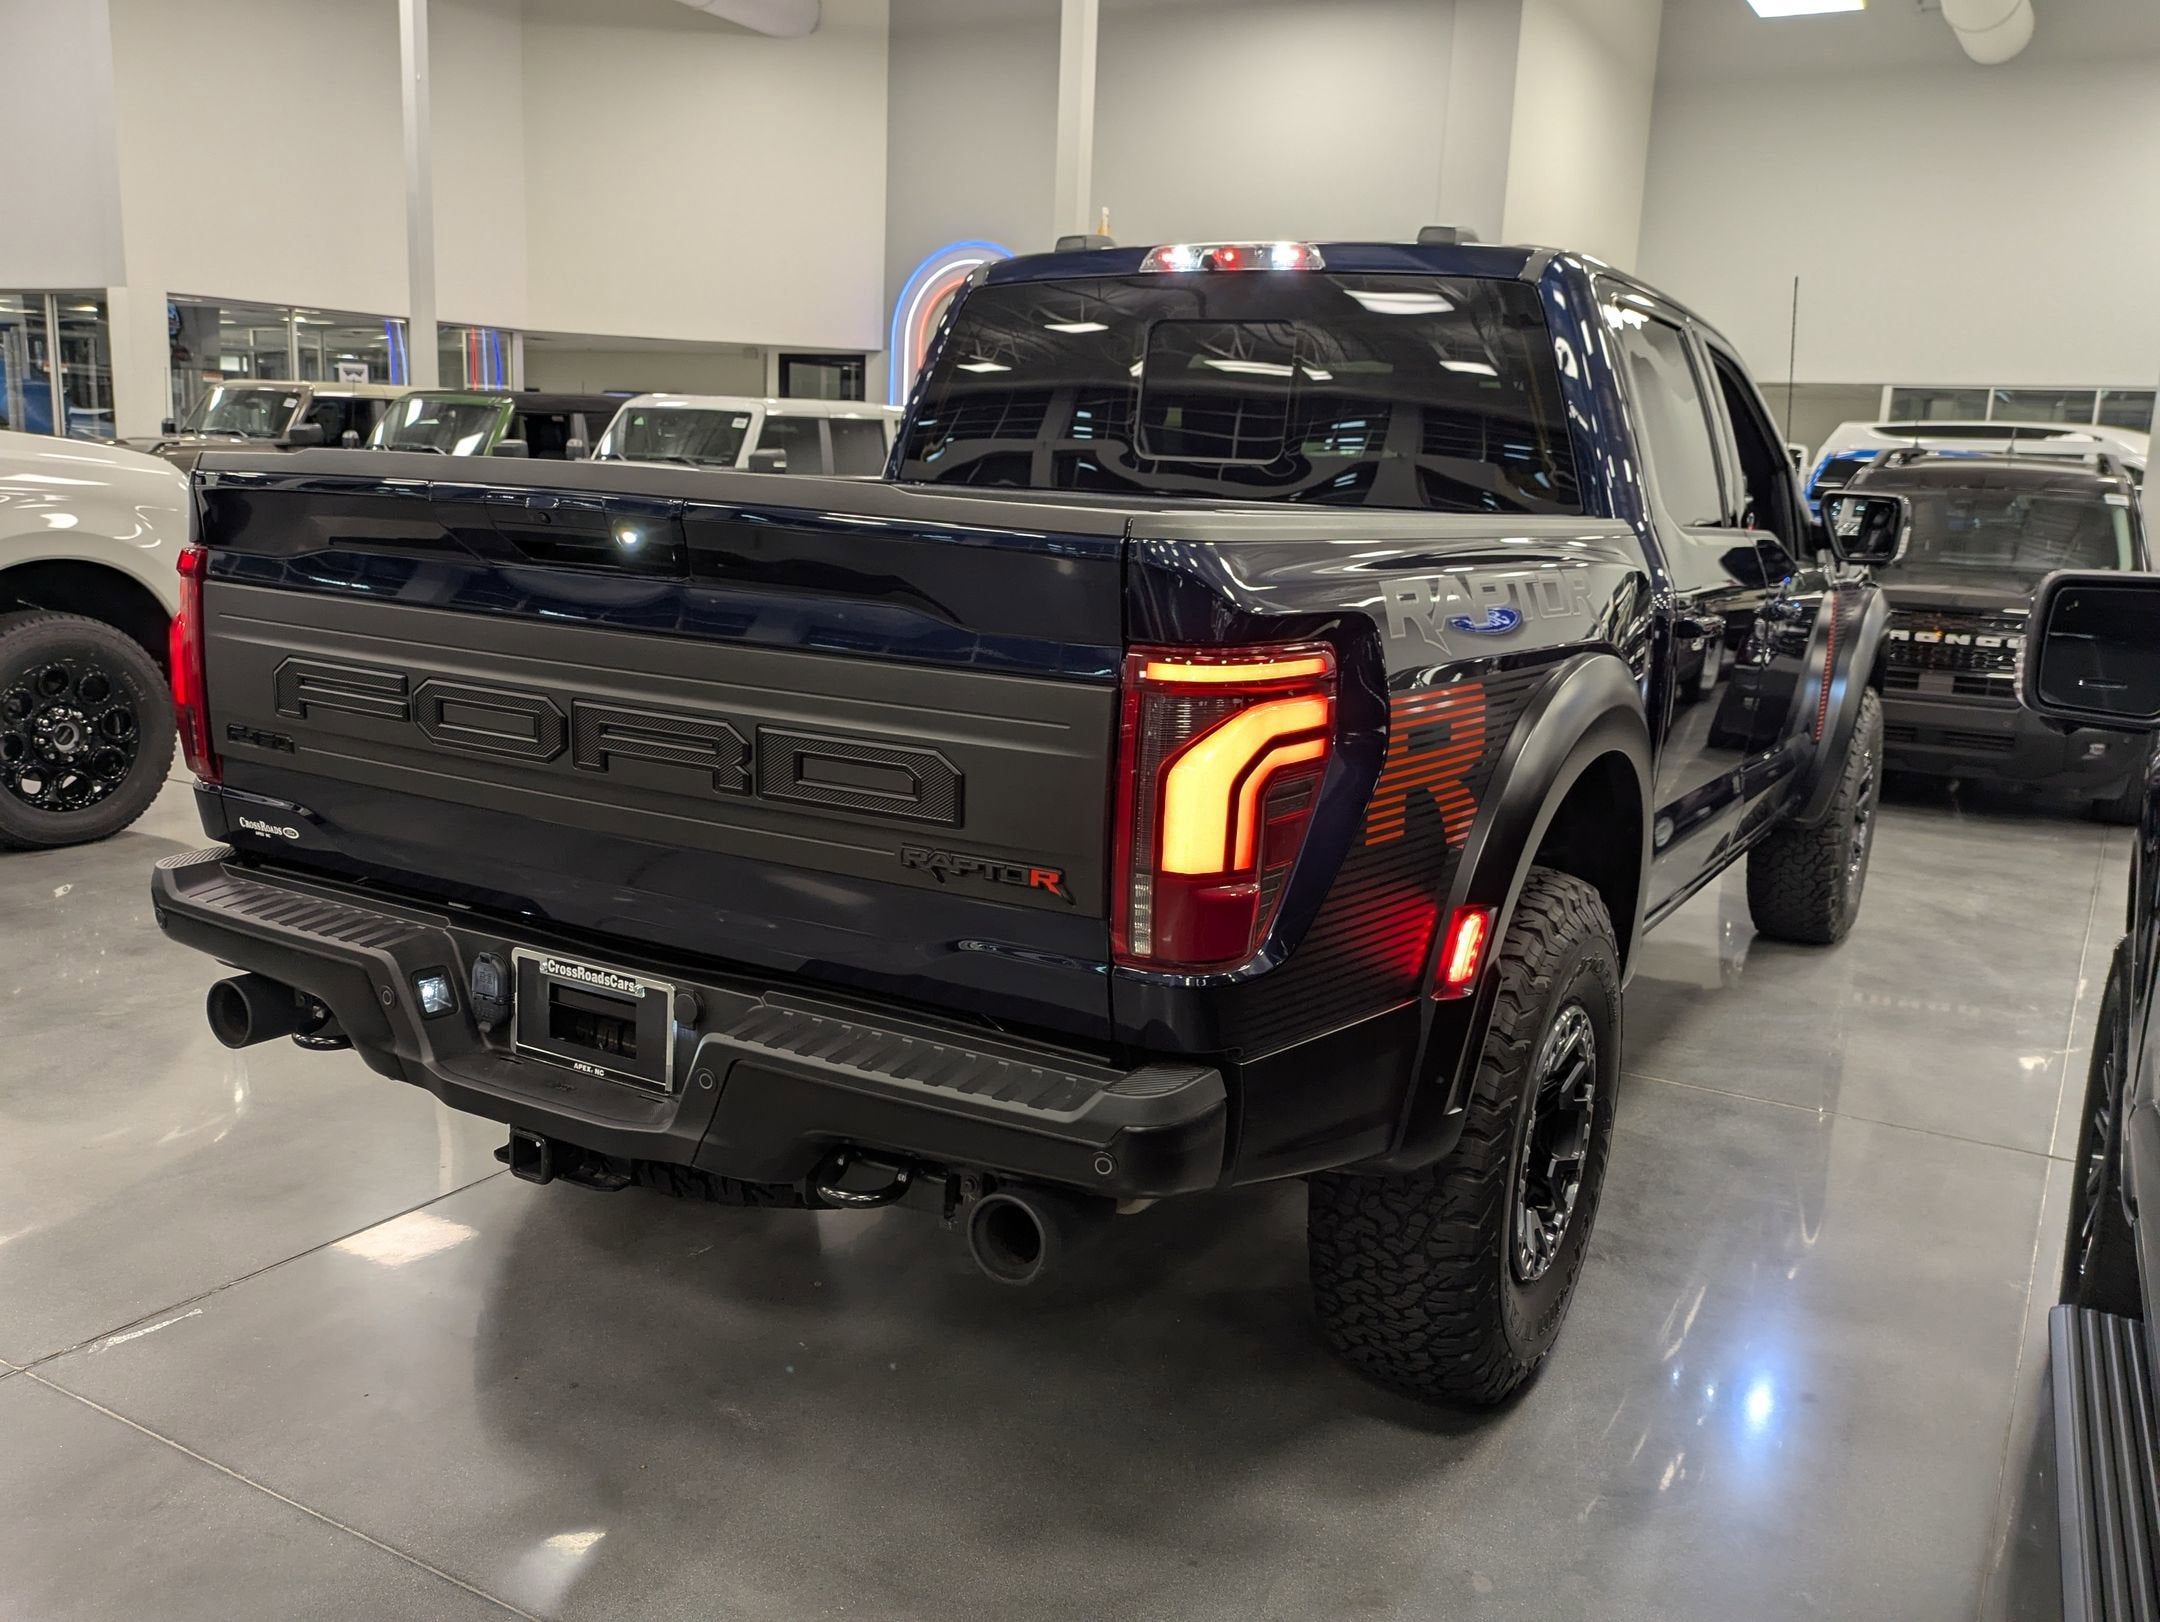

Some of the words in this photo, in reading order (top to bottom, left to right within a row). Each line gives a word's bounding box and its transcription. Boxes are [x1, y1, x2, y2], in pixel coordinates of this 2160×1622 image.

[1379, 568, 1599, 657] RAPTOR
[1889, 629, 2021, 649] RONC
[273, 655, 965, 829] FORD
[900, 842, 1077, 907] RAPTOR
[547, 958, 636, 993] CrossRoadsCars
[594, 1067, 606, 1077] NC
